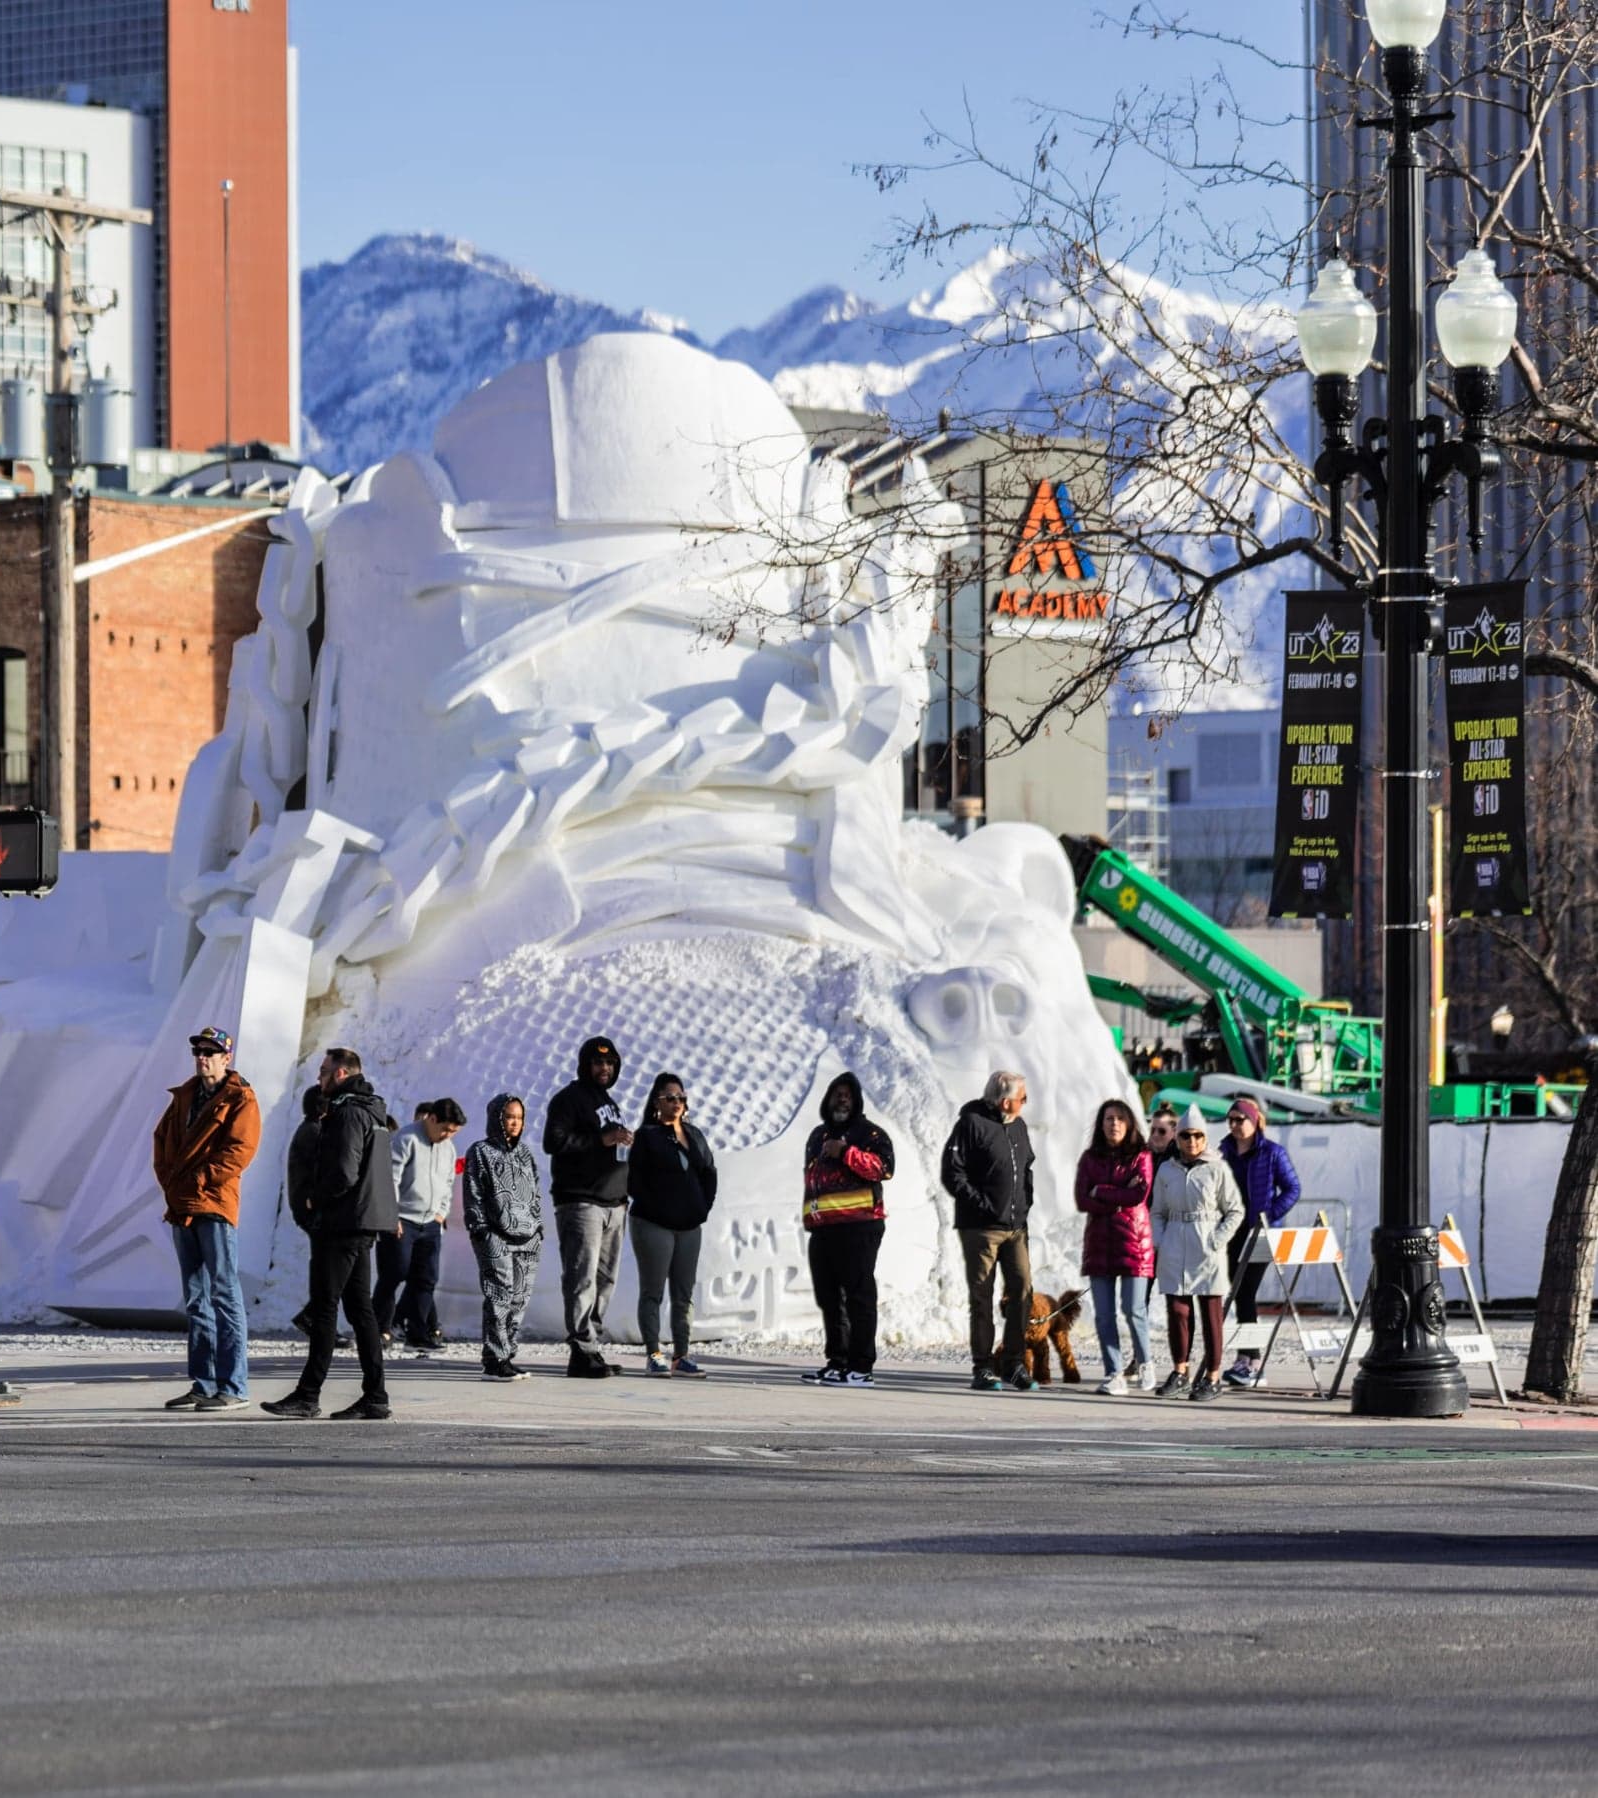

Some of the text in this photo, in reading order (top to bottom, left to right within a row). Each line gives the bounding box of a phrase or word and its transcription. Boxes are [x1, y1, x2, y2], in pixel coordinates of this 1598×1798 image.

[997, 586, 1112, 621] ACADEMY
[1288, 635, 1360, 656] UT 23
[1448, 626, 1521, 651] UT 23
[1288, 672, 1322, 690] FEBRUARY
[1323, 672, 1342, 689] 17-19
[1450, 667, 1487, 685] FEBRUARY
[1286, 724, 1354, 745] UPGRADE YOUR
[1454, 716, 1518, 741] UPGRADE YOUR
[1291, 765, 1344, 785] EXPERIENCE
[1463, 758, 1512, 782] EXPERIENCE
[1137, 901, 1283, 1017] SUNBELT RENTALS
